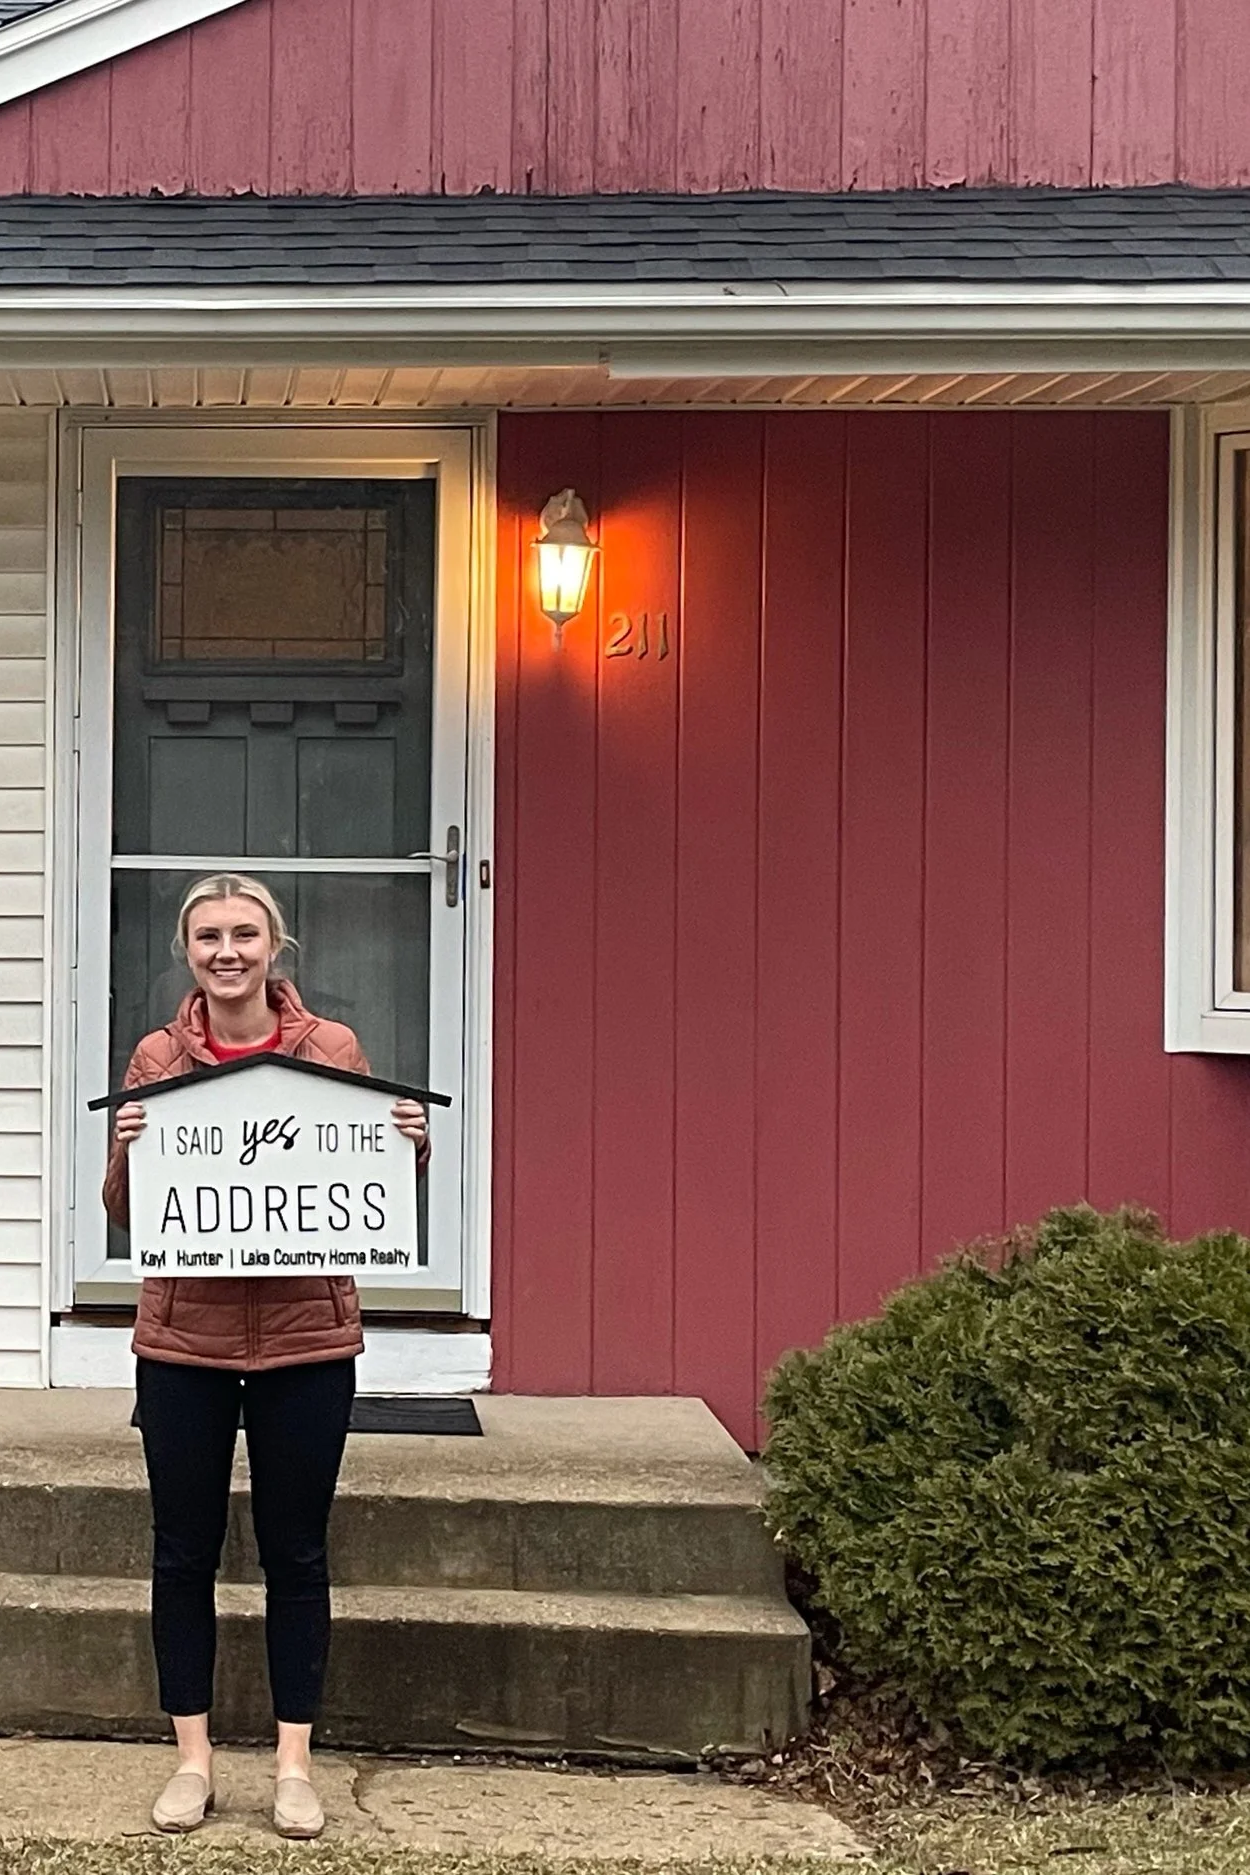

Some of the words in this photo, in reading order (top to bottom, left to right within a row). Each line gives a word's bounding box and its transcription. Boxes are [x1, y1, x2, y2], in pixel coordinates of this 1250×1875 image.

[605, 612, 669, 661] 211
[176, 1125, 223, 1156] SAID
[238, 1114, 301, 1166] yes
[314, 1123, 339, 1153] TO
[347, 1123, 386, 1153] THE
[160, 1182, 386, 1235] ADDRESS
[176, 1249, 224, 1267] Hunter
[240, 1248, 271, 1267] Lake
[273, 1247, 327, 1269] Country
[328, 1248, 367, 1266] Home
[369, 1247, 411, 1268] Realty
